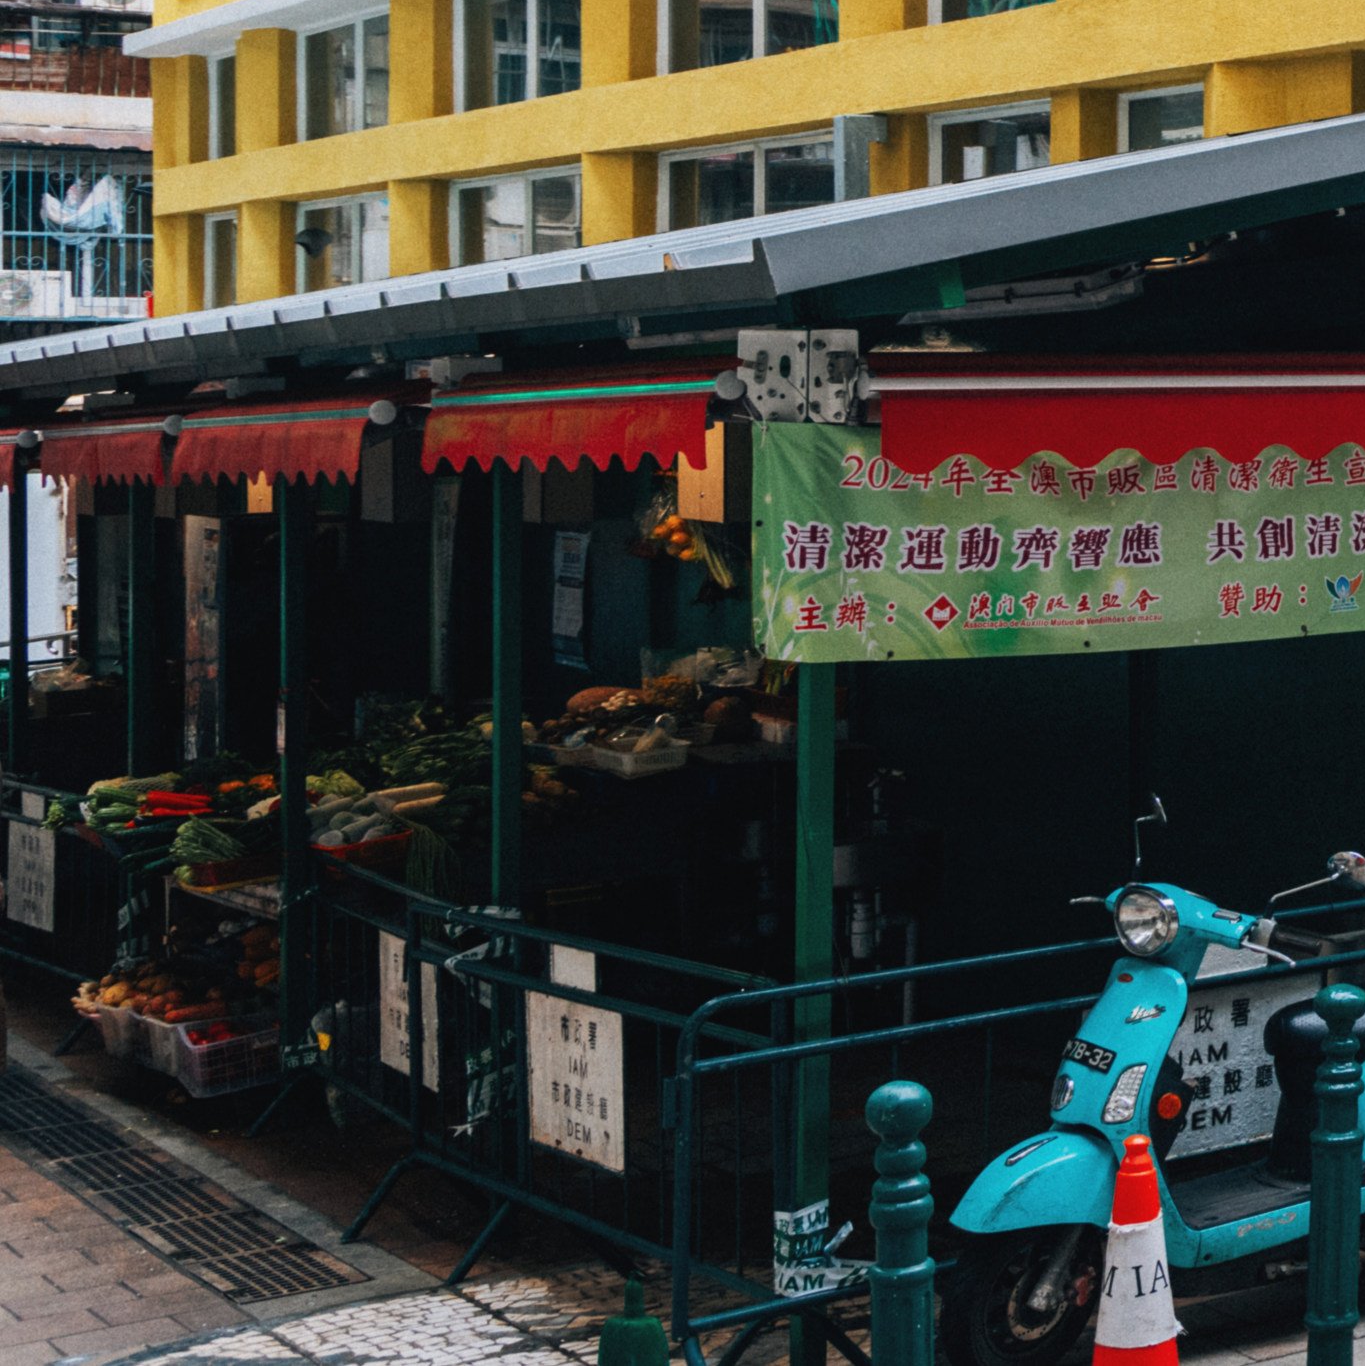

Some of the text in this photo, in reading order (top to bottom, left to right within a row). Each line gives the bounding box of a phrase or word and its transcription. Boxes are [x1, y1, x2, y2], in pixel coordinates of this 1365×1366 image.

[784, 521, 1163, 574] 清潔運動齊響應
[1010, 619, 1019, 628] de
[1076, 616, 1085, 625] de
[1127, 614, 1137, 623] de
[566, 1117, 592, 1145] DEM
[779, 1273, 826, 1292] IAM
